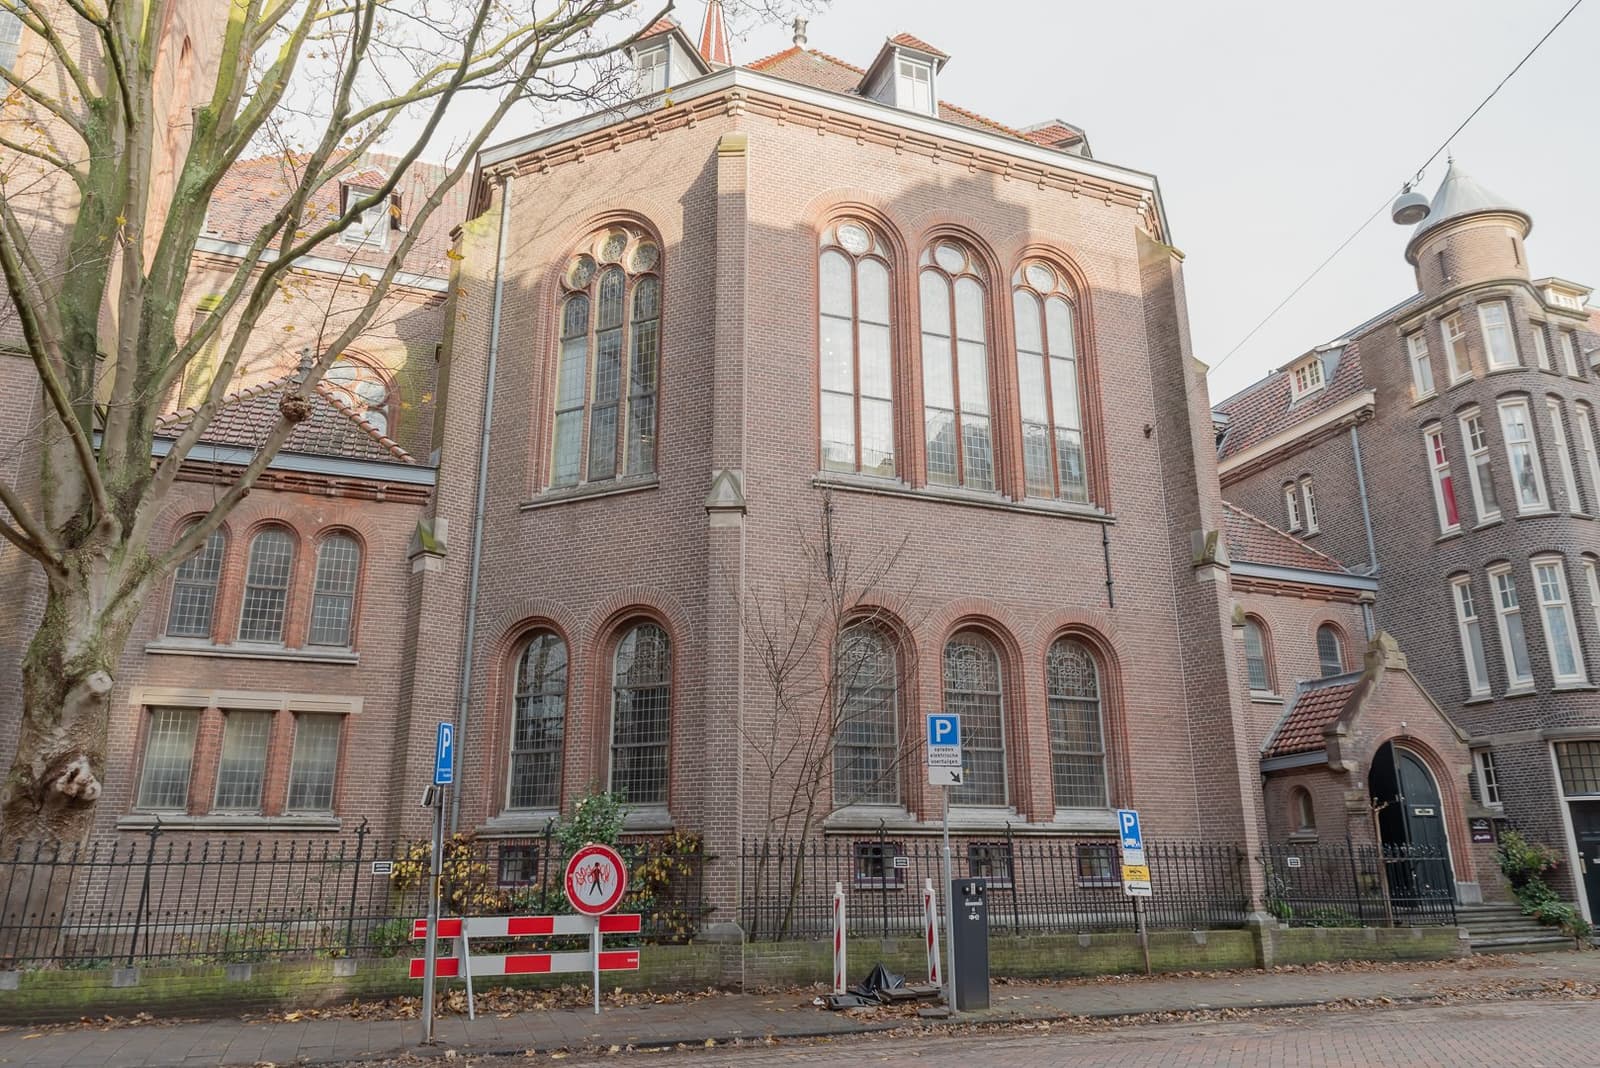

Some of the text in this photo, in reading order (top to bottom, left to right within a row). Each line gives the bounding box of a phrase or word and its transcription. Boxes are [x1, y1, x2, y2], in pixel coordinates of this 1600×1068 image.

[935, 719, 952, 742] P
[441, 727, 451, 758] P
[1122, 813, 1135, 834] P
